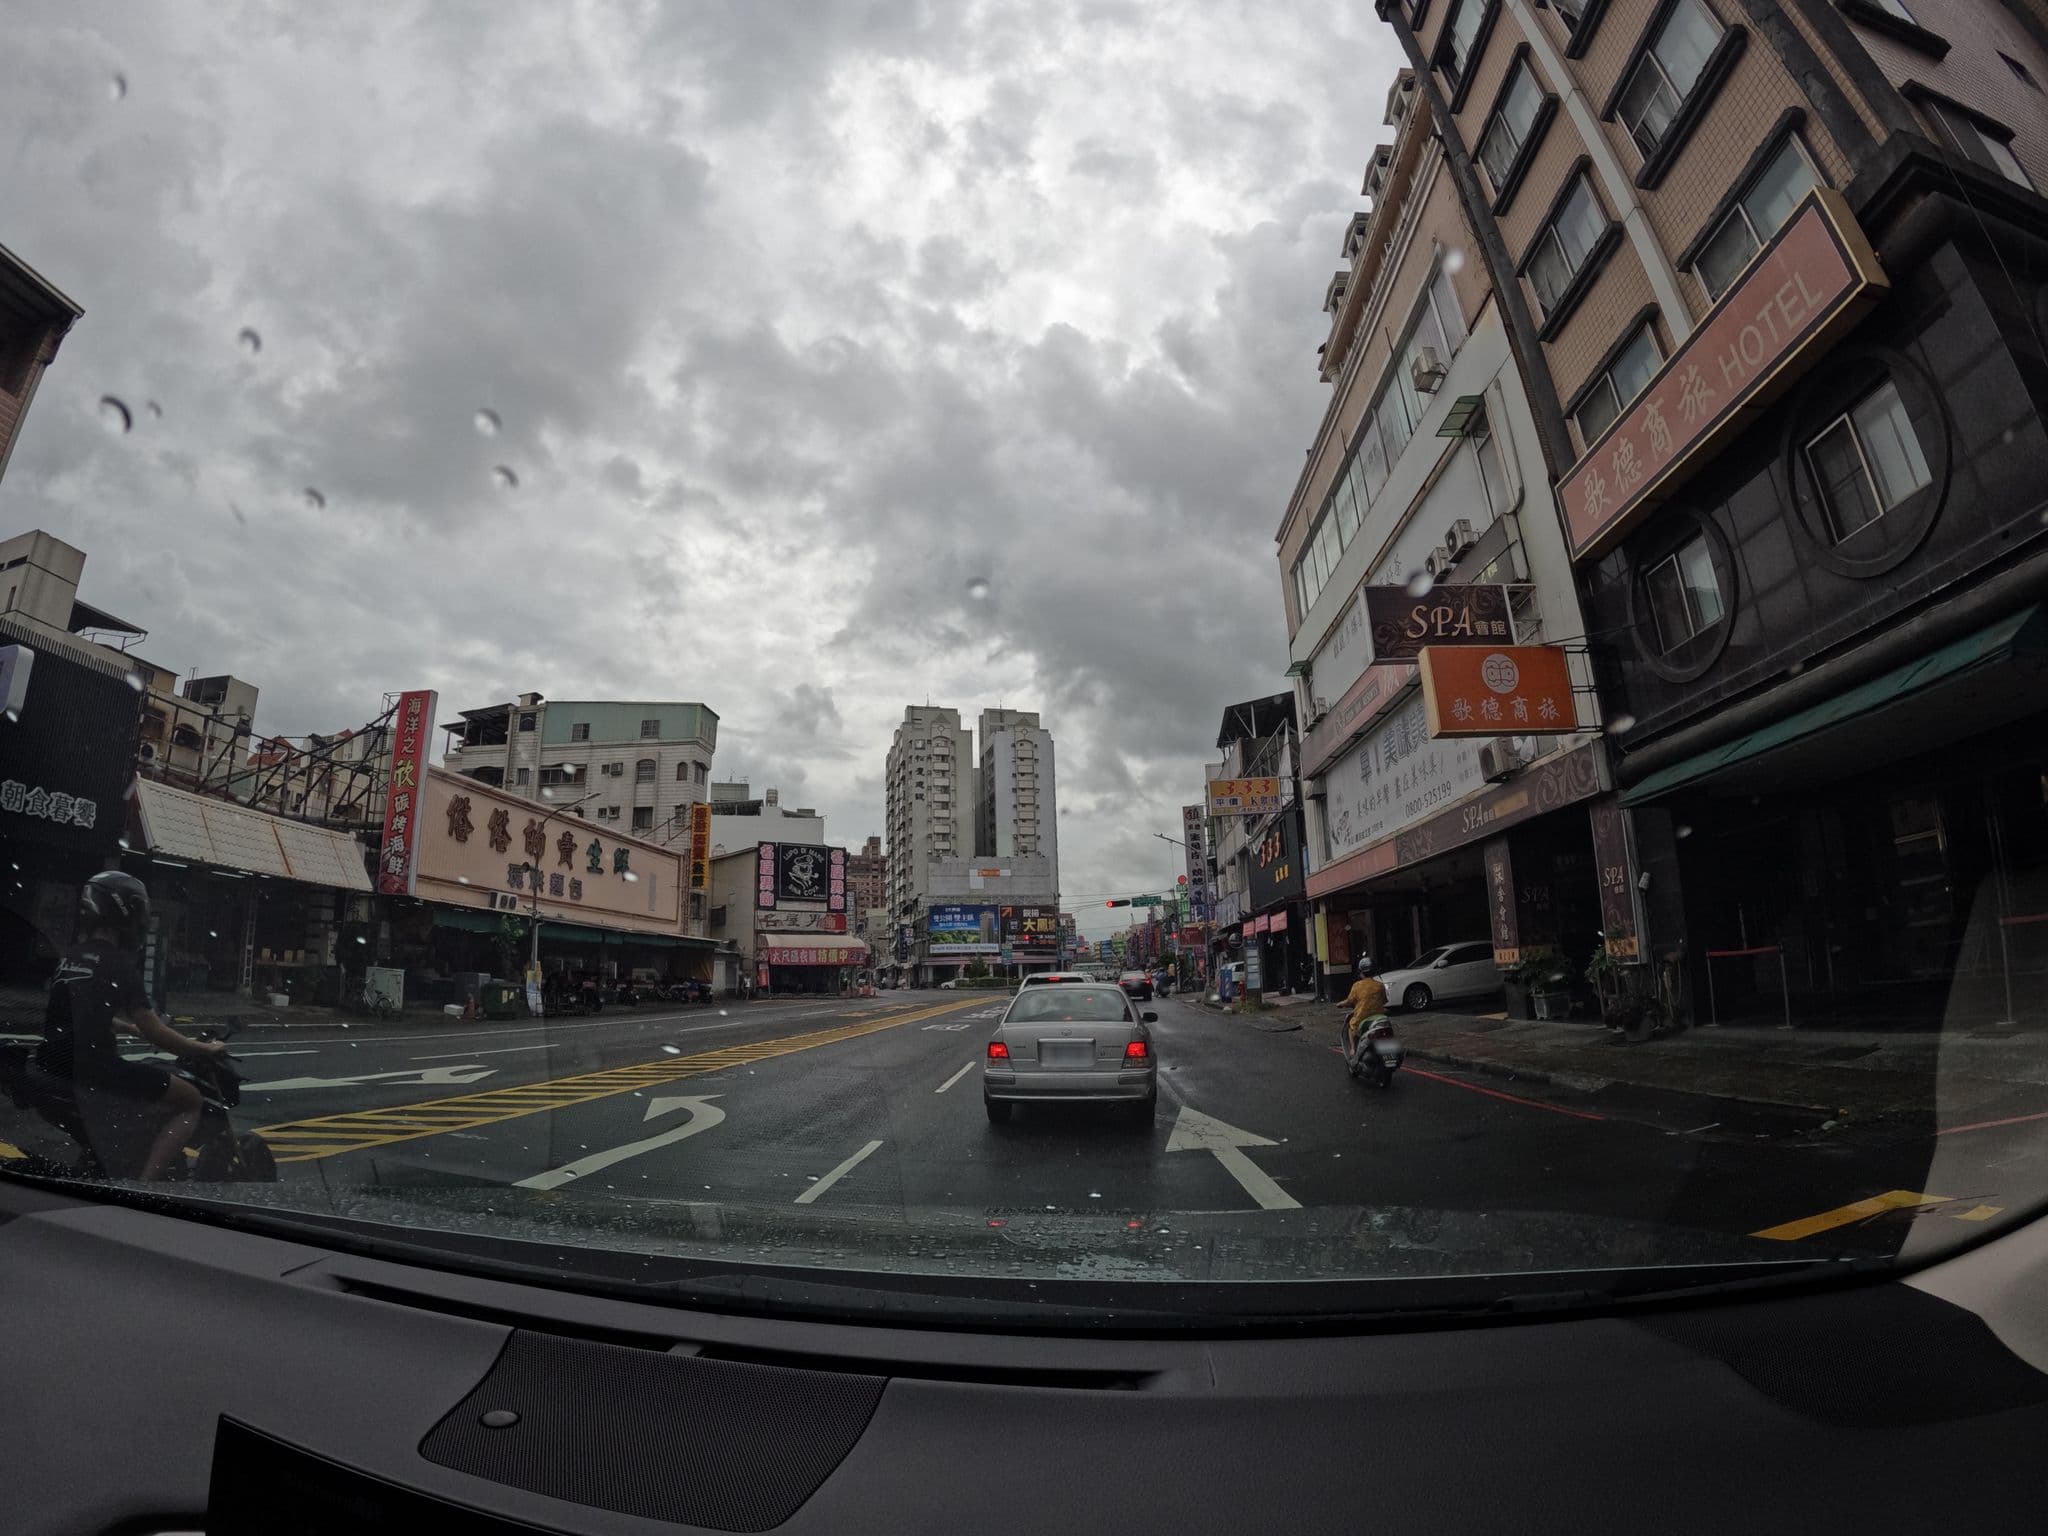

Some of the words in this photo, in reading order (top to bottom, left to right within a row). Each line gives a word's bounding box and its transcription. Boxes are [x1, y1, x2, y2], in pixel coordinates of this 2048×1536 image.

[1583, 364, 1717, 521] 歌德商旅
[1718, 270, 1823, 390] HOTEL
[1450, 696, 1561, 723] 歌德商旅
[1220, 779, 1271, 796] 333
[1405, 780, 1452, 818] 0800-525199
[1603, 865, 1625, 888] SPA
